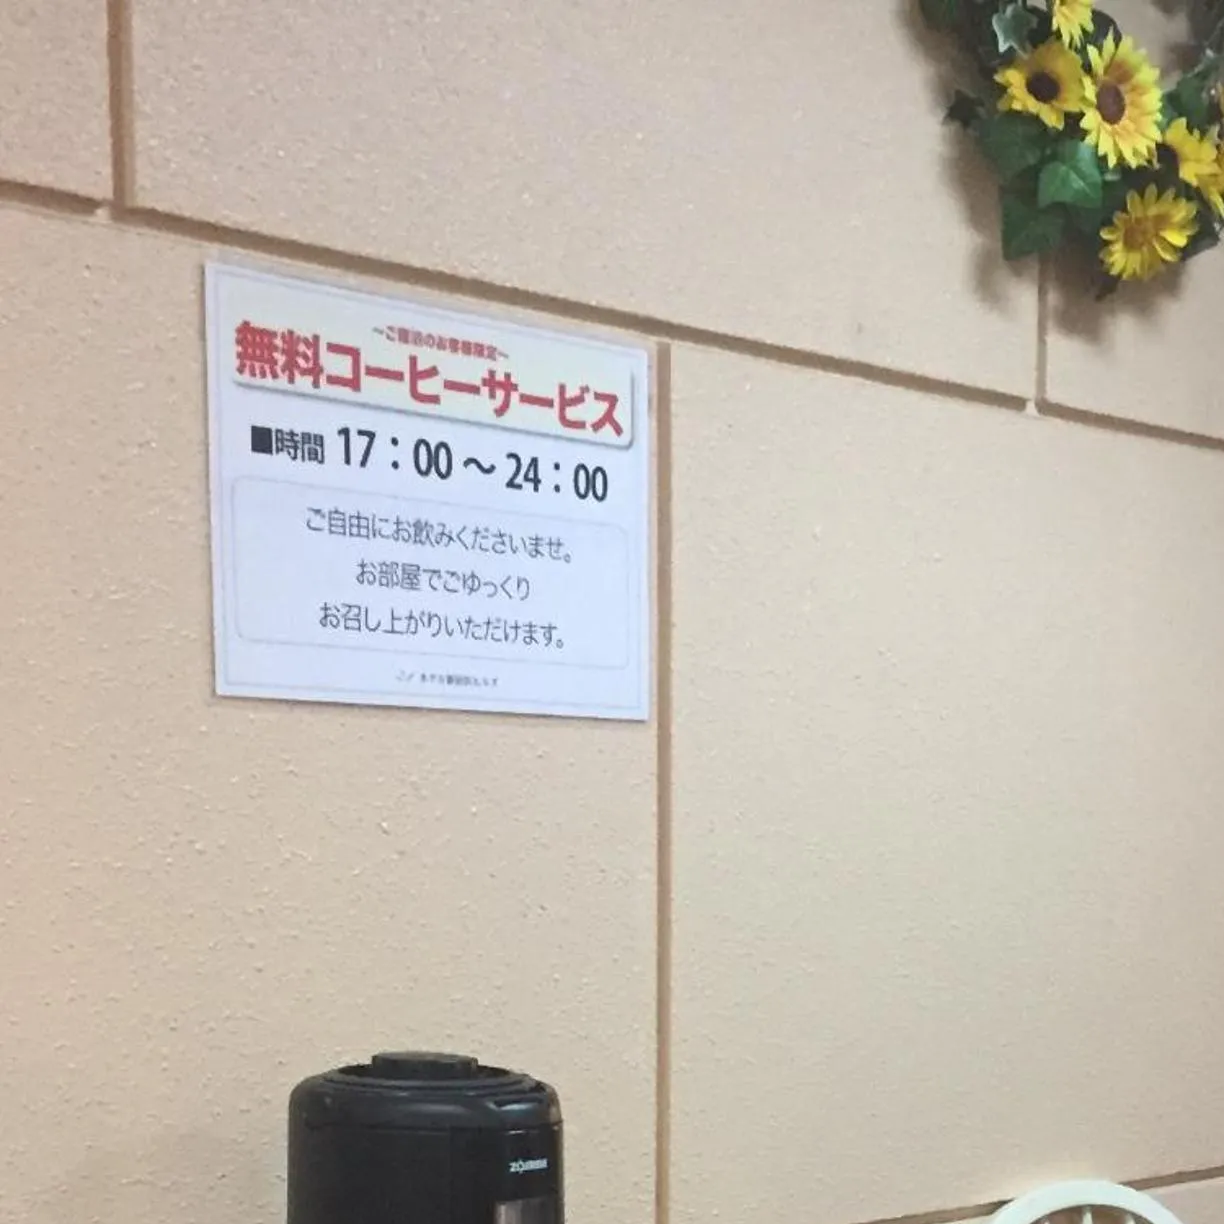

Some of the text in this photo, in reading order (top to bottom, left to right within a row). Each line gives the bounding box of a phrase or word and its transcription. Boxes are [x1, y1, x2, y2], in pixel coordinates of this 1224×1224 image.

[234, 320, 624, 437] 無料コーヒーサービス
[275, 428, 325, 464] 時間
[306, 507, 571, 563] ご自由にお飲みくださいませ。
[356, 559, 531, 600] お部屋でごゆっくり
[319, 602, 564, 649] お召し上がりいただけます。
